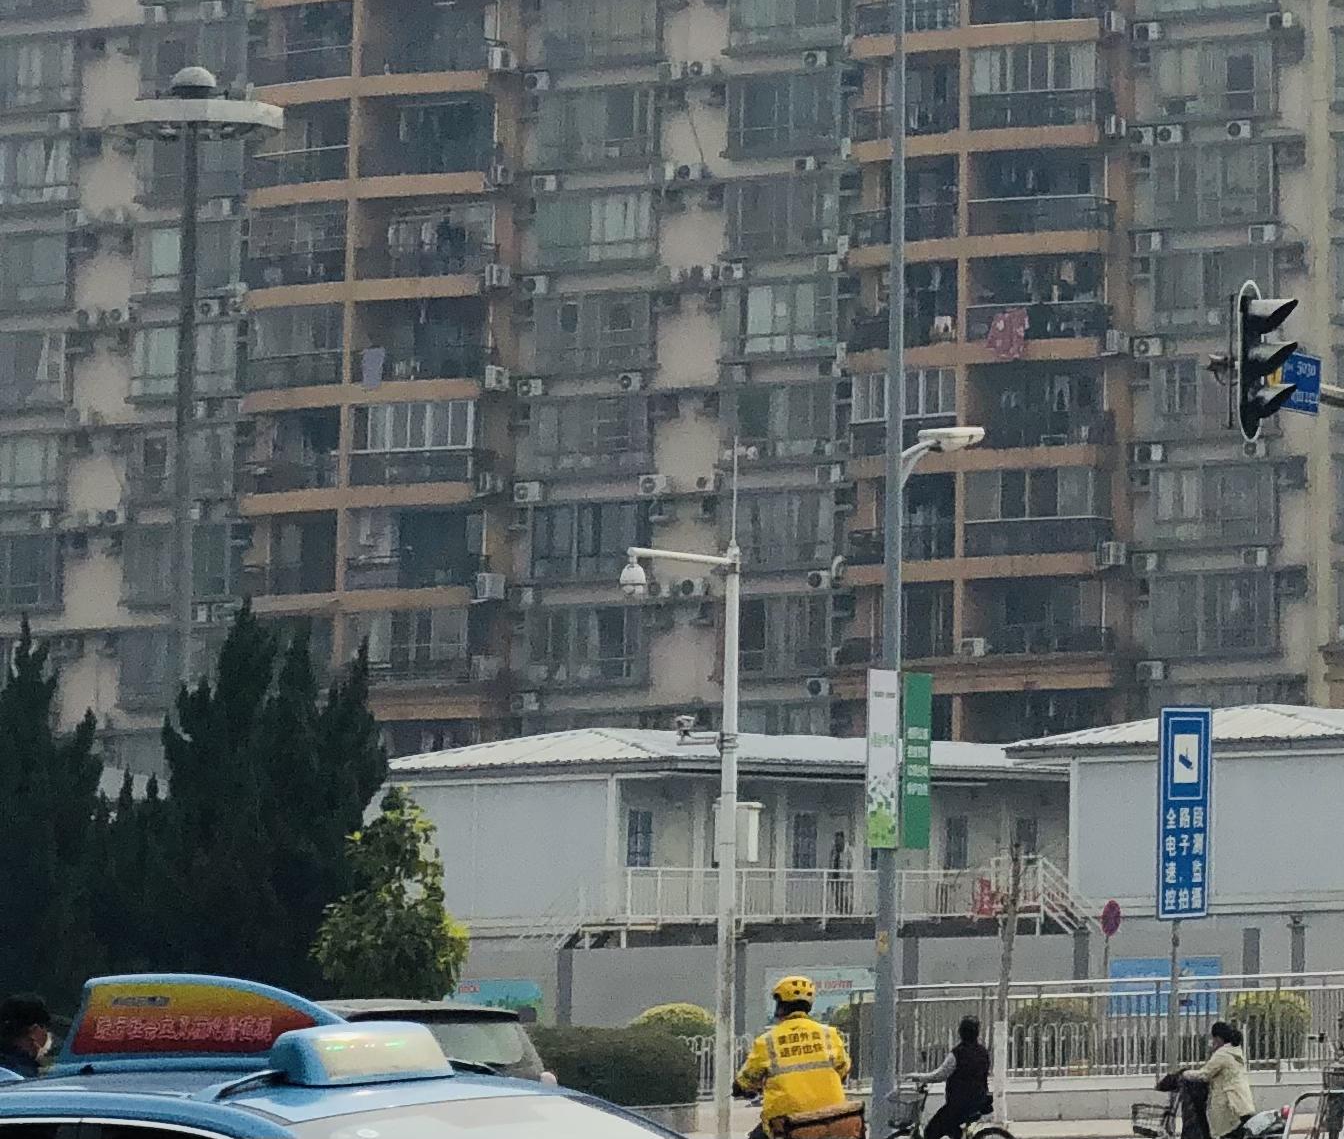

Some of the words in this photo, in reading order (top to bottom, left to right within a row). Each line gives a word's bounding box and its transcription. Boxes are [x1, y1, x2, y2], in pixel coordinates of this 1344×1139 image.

[1166, 806, 1204, 829] 全路段
[1165, 833, 1204, 857] 电子测
[1164, 887, 1203, 911] 控拍摄
